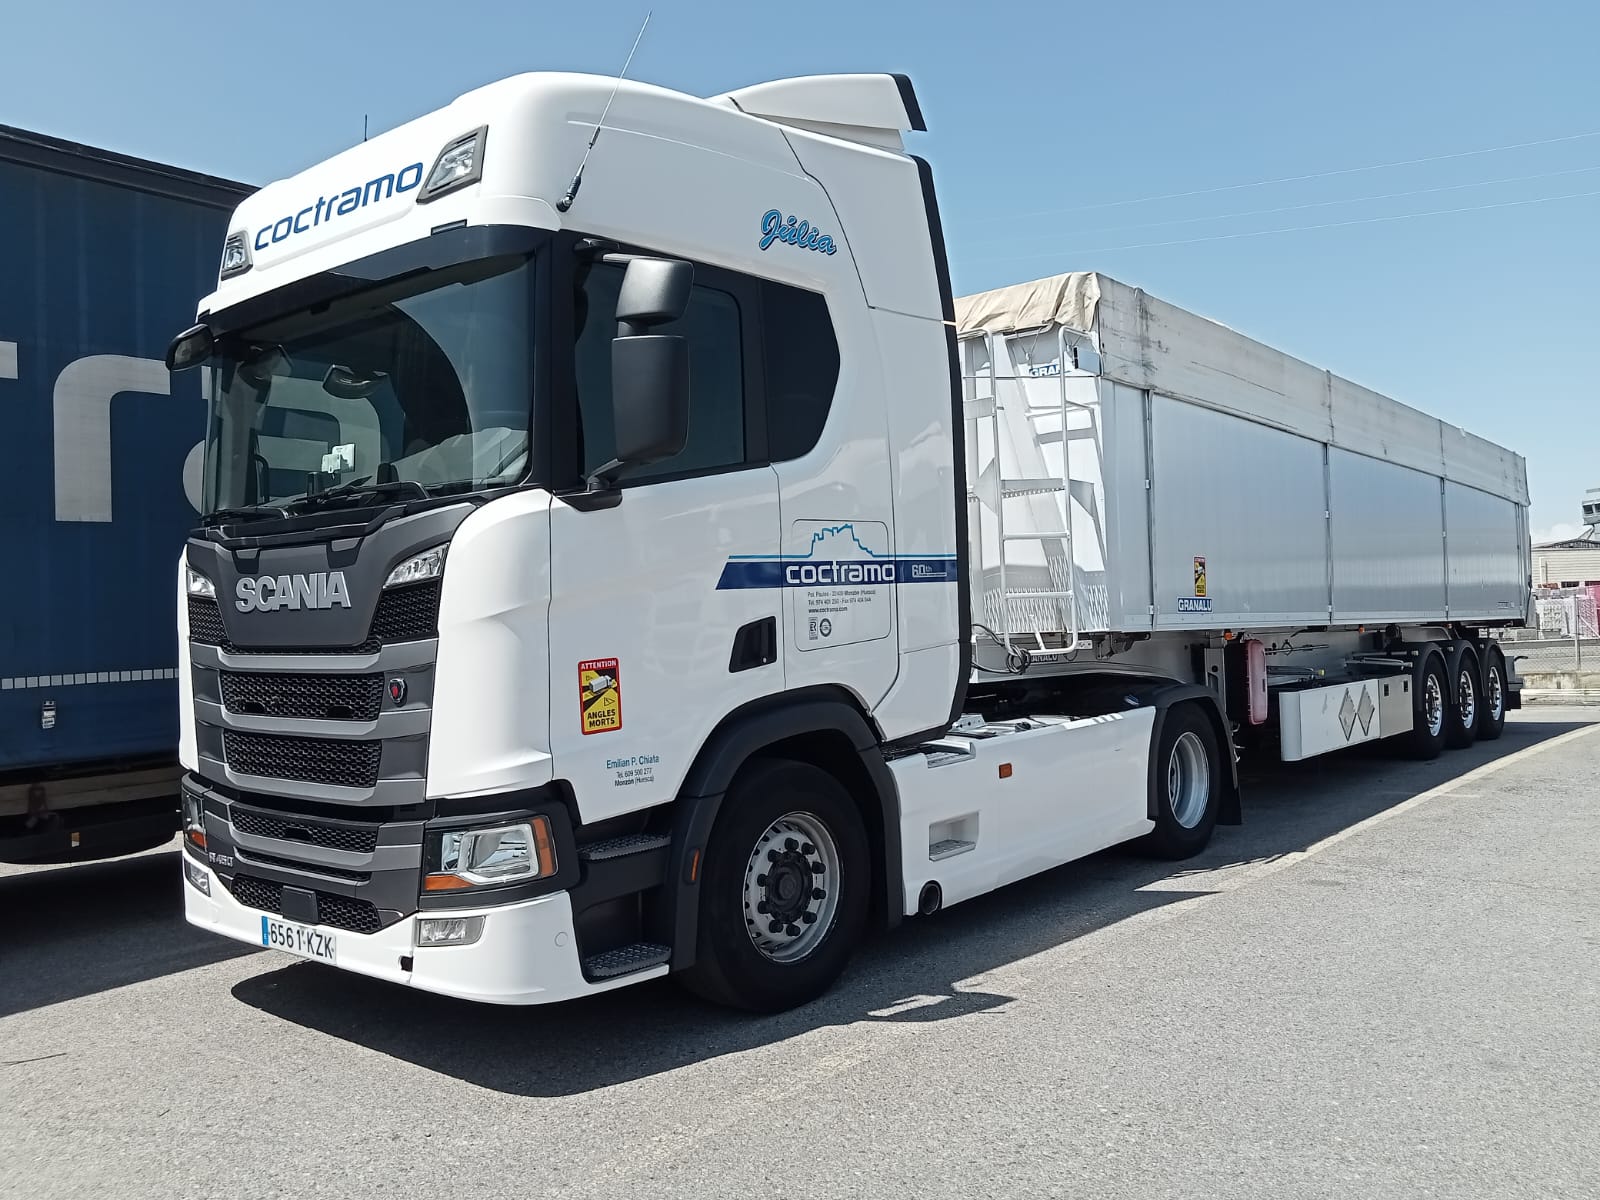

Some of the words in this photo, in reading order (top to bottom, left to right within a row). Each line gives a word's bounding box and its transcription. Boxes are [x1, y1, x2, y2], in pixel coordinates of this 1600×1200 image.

[255, 162, 423, 251] coctramo
[786, 560, 895, 584] coctramo
[235, 571, 352, 612] SCANIA
[1178, 599, 1212, 611] GRANALU
[581, 660, 617, 670] ATTENTION
[587, 709, 616, 720] ANGLES
[589, 717, 615, 728] MORTS
[606, 758, 630, 769] Emilian
[631, 756, 638, 766] P.
[270, 923, 302, 951] 6561
[307, 931, 333, 959] KZK
